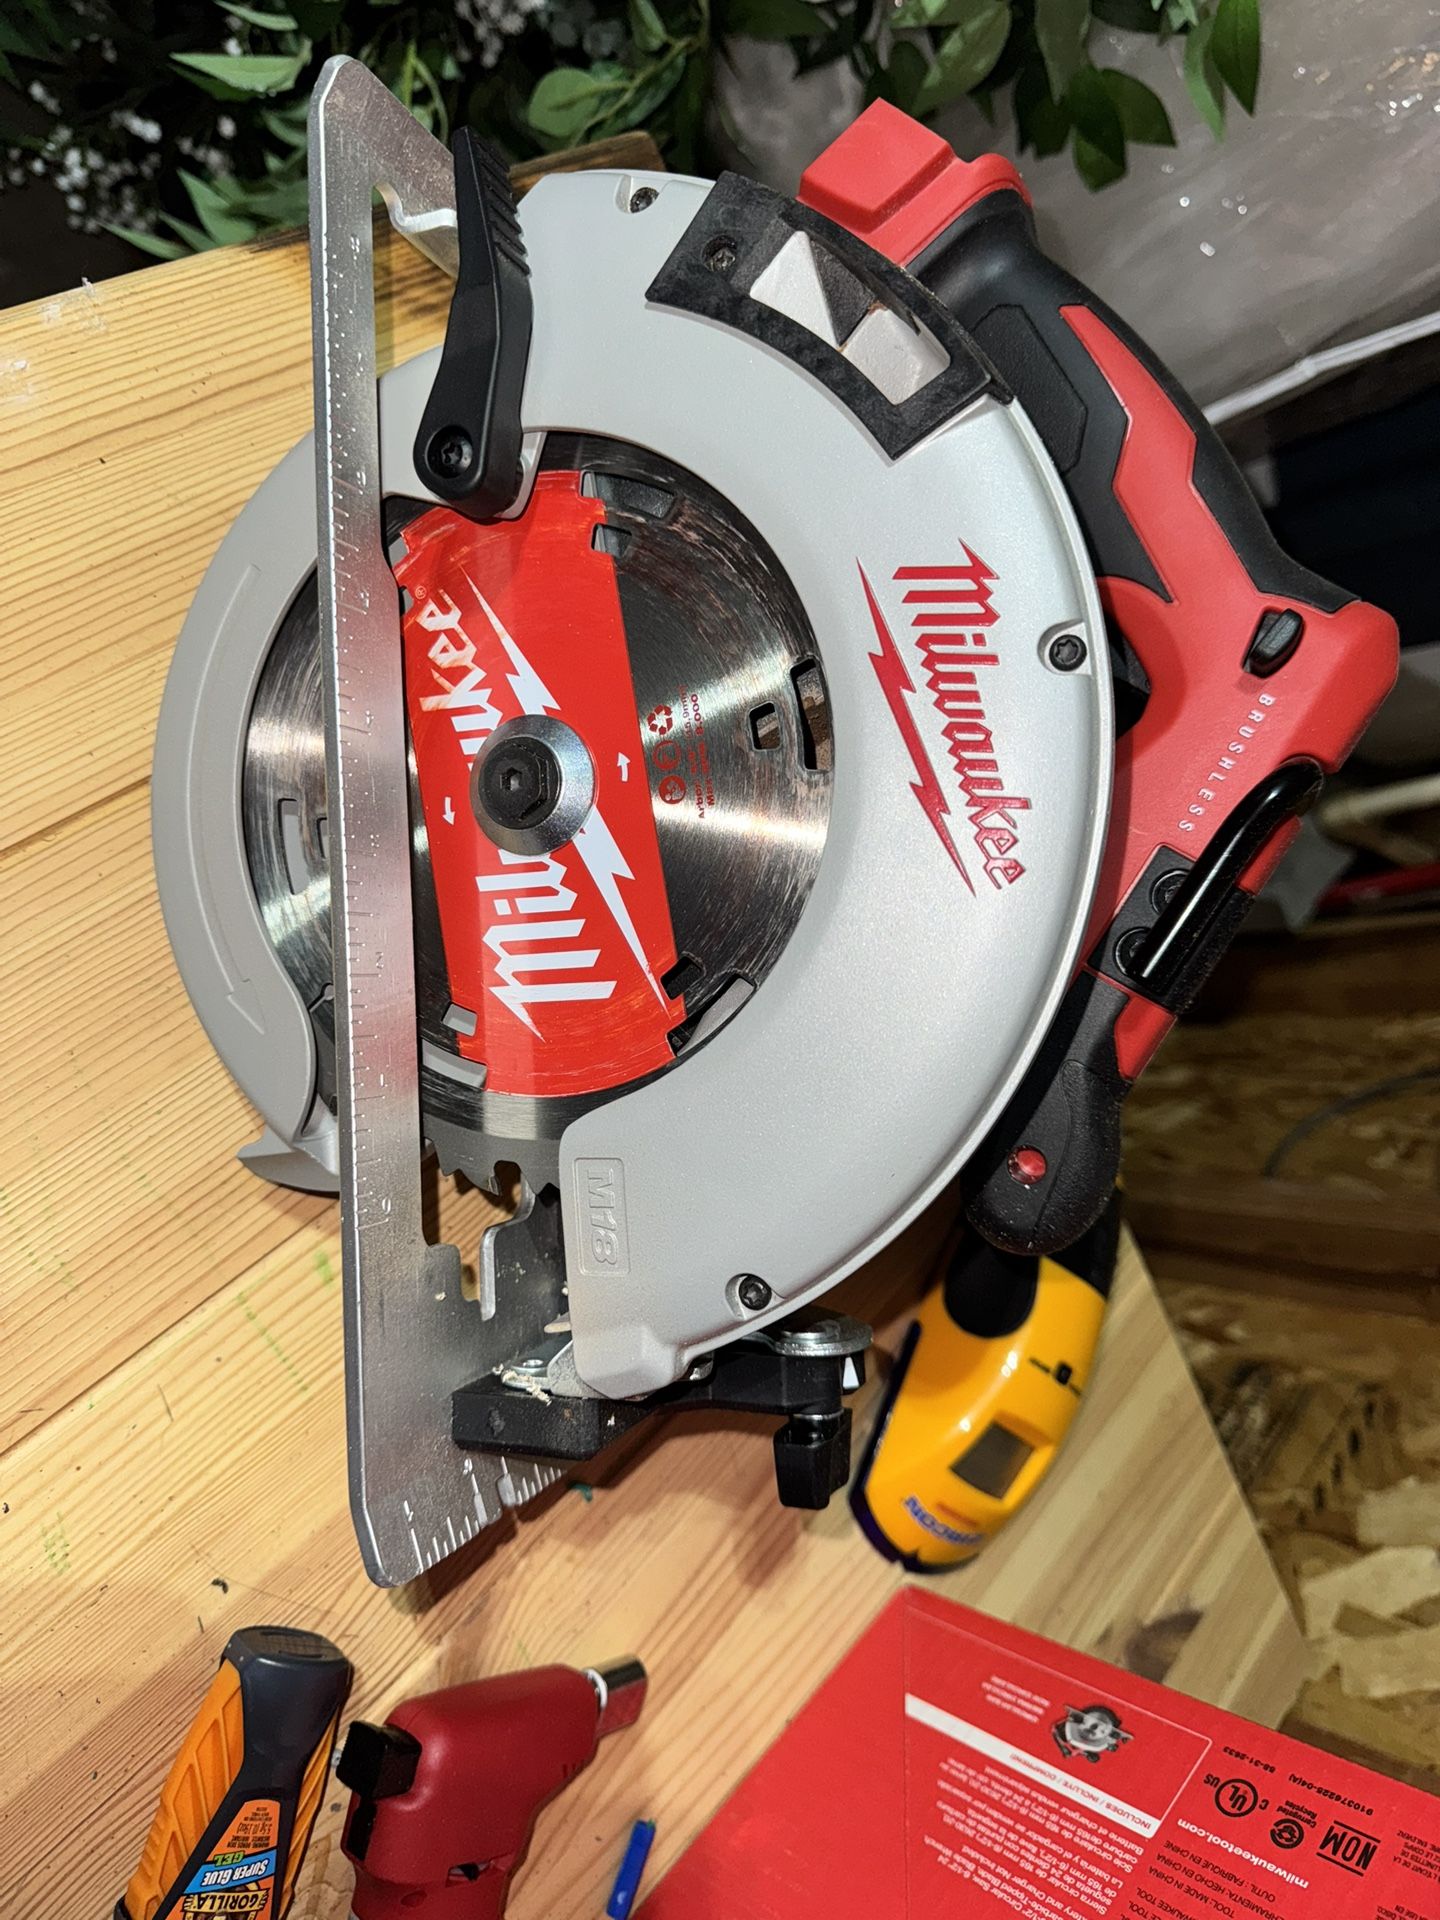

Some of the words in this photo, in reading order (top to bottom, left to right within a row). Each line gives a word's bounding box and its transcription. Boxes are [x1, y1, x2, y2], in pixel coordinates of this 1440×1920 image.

[892, 538, 1032, 889] Milwaukee
[1178, 693, 1276, 832] BRUSHLESS
[415, 588, 617, 1043] Milukee
[587, 1168, 618, 1265] M18
[1202, 1772, 1220, 1788] US
[1177, 1817, 1309, 1888] milwaukeetool.com
[1319, 1826, 1377, 1870] NOM
[213, 1851, 244, 1866] GEL
[1154, 1852, 1182, 1871] CHINA
[201, 1868, 231, 1886] GLUE
[233, 1859, 268, 1881] SUPER
[1147, 1865, 1174, 1883] CHINA
[1172, 1879, 1184, 1889] IN
[1182, 1884, 1209, 1903] MADE
[197, 1894, 259, 1910] GORILLA
[1078, 1893, 1108, 1915] Sierra
[1133, 1886, 1157, 1904] TOOL
